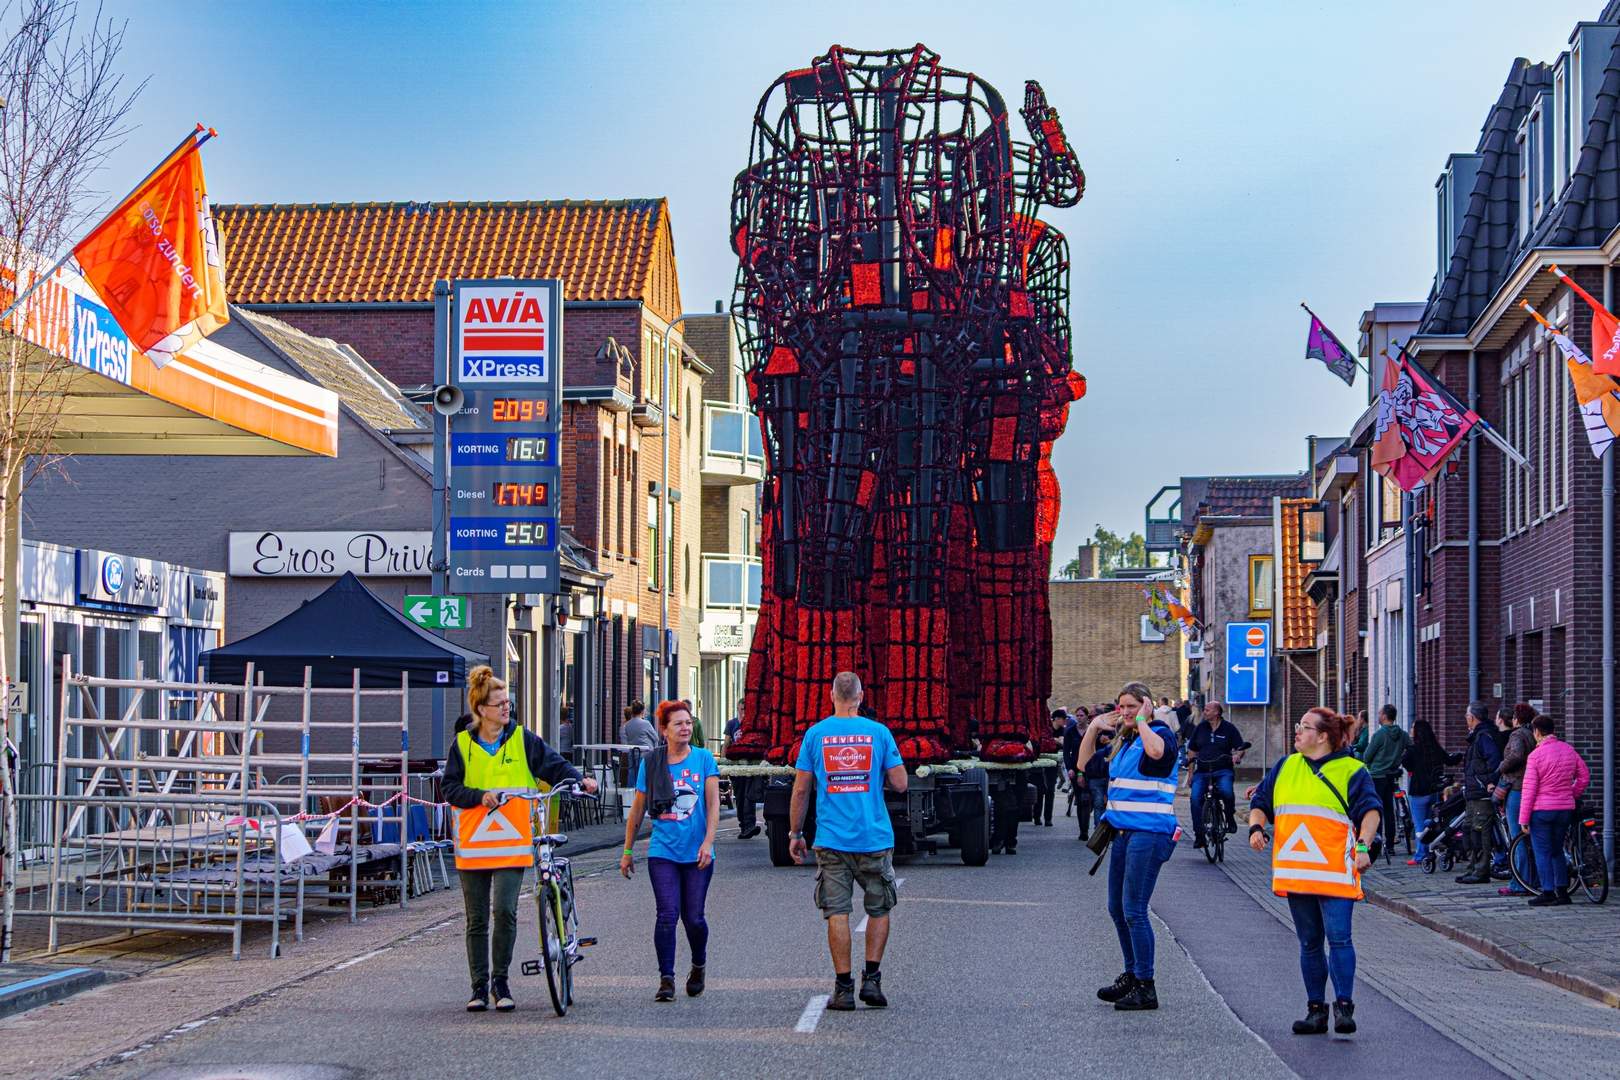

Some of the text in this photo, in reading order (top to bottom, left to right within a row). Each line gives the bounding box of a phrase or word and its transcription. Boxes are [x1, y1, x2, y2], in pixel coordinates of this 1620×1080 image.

[139, 201, 204, 299] corso zundert
[75, 304, 126, 382] XPress
[467, 359, 541, 378] XPress
[457, 444, 499, 454] KORTING
[457, 489, 486, 499] Diesel
[456, 528, 498, 538] KORTING
[253, 532, 335, 575] Eros
[134, 567, 159, 592] Service
[456, 566, 485, 577] Cards
